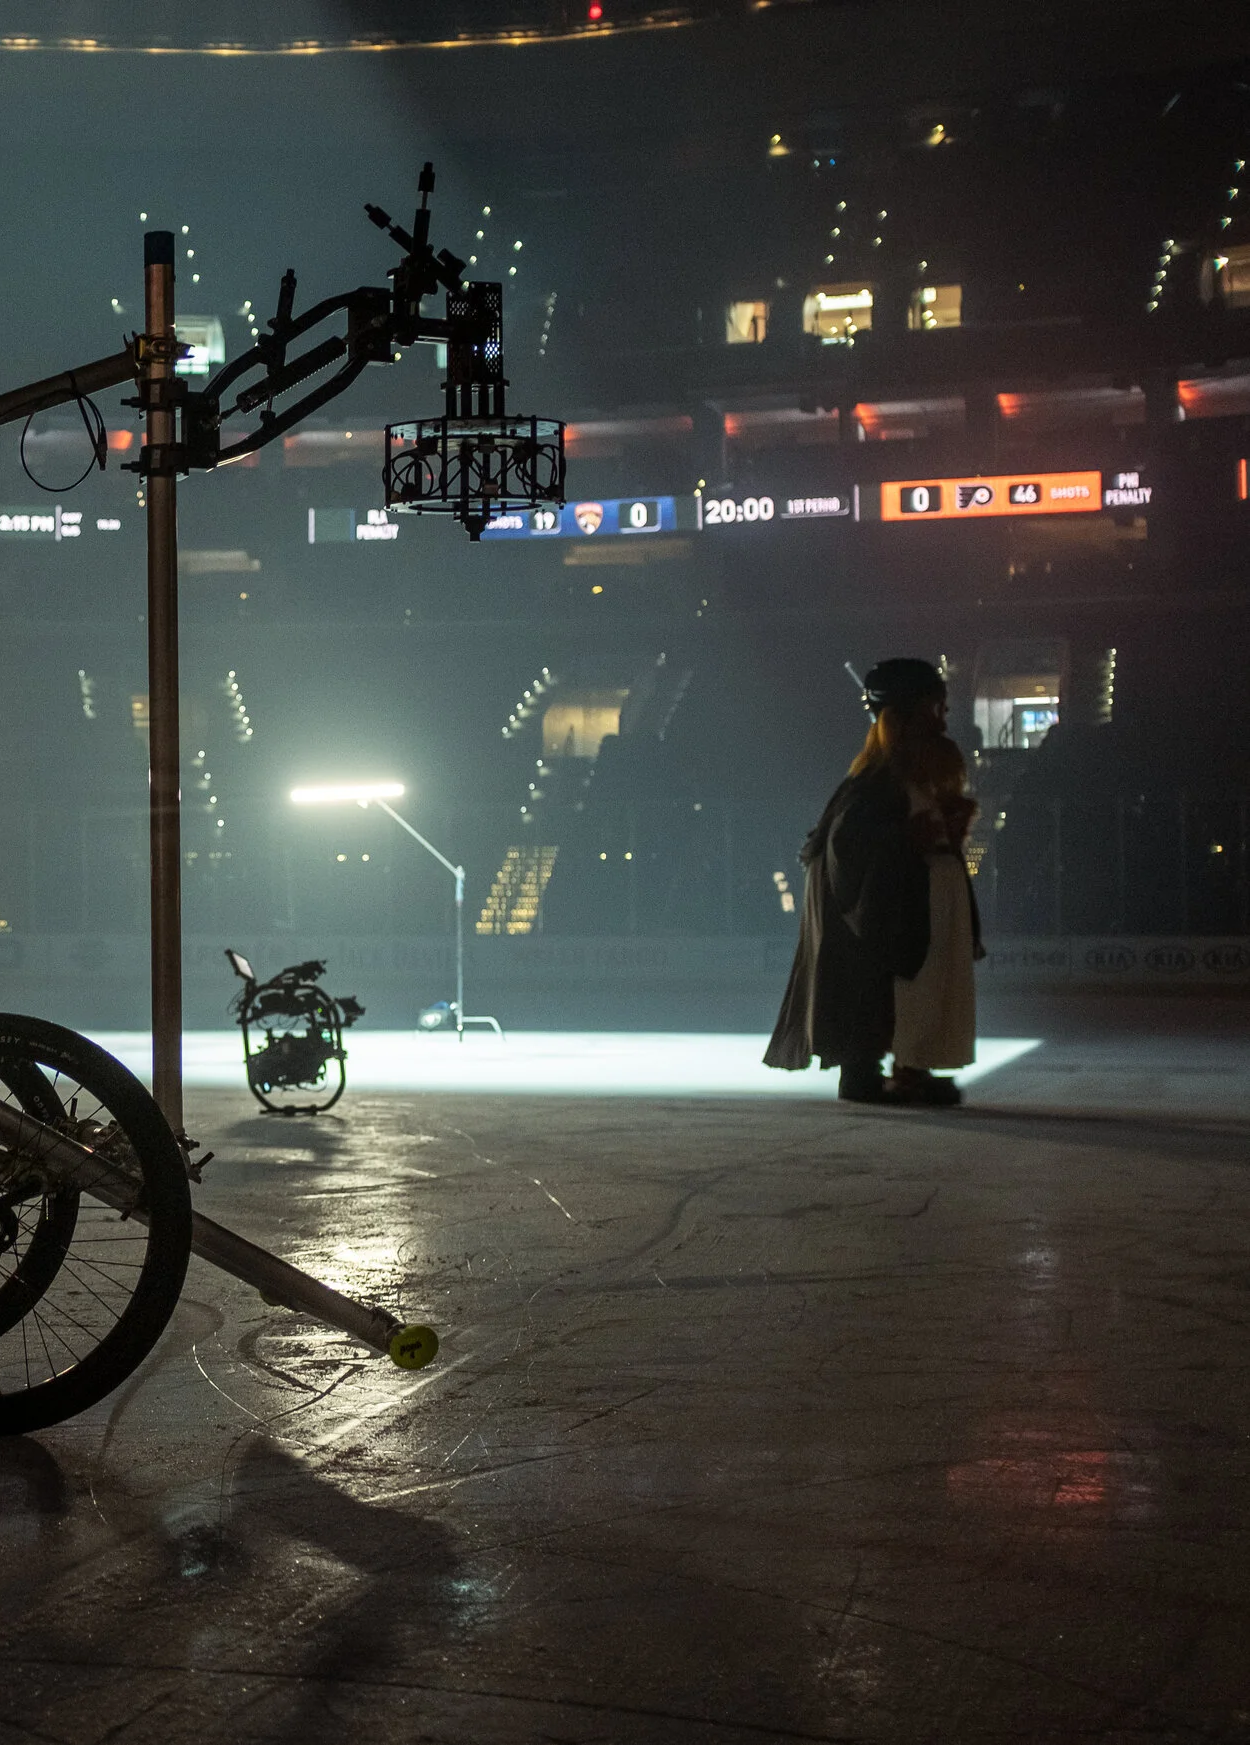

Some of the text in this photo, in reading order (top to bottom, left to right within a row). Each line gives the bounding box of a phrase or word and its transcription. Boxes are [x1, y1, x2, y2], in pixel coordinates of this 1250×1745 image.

[912, 486, 930, 512] 0
[1014, 484, 1090, 503] 46 SHOTS
[1105, 486, 1152, 505] PENALTY
[533, 511, 555, 530] 19
[629, 502, 647, 528] 0
[705, 496, 774, 524] 20:00
